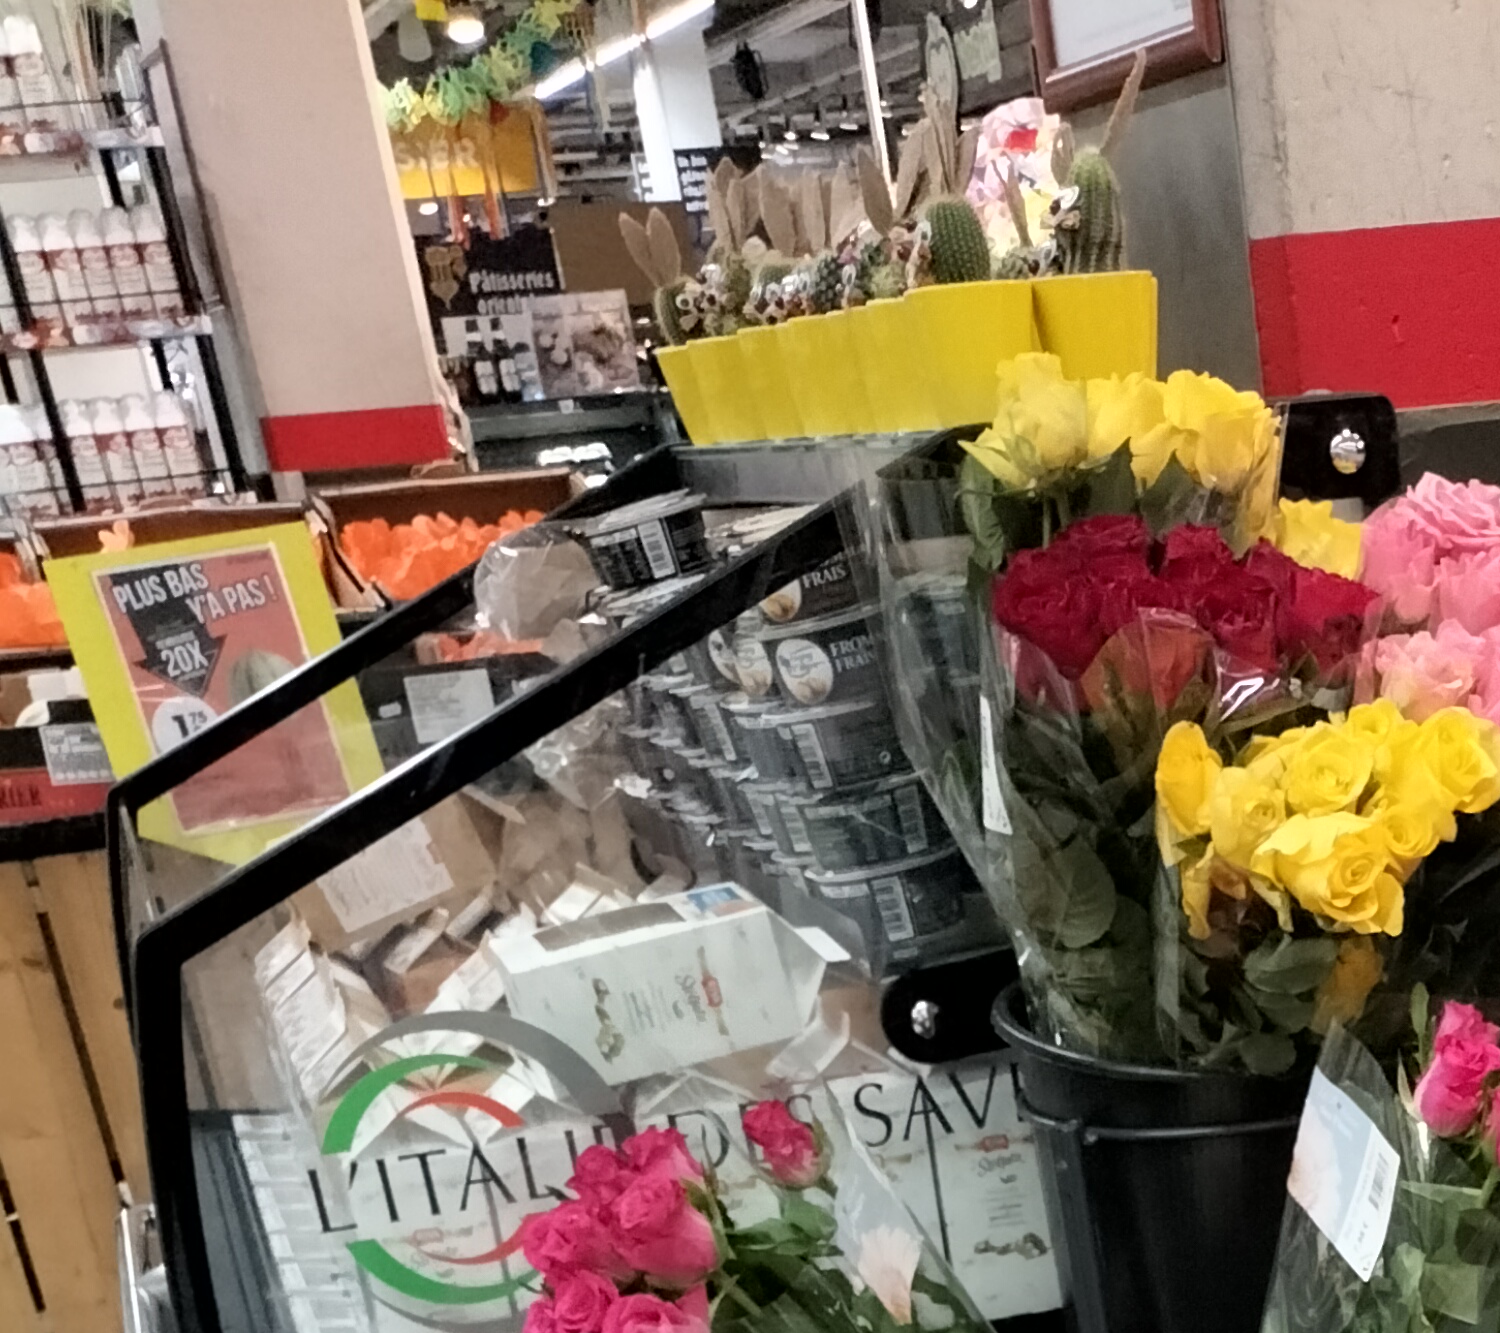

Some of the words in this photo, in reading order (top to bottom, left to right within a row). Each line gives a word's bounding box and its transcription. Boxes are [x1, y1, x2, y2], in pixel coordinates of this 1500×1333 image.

[112, 573, 168, 614] PLUS
[163, 562, 210, 600] BAS
[801, 562, 847, 589] FRAIS
[184, 593, 226, 625] Y'A
[221, 579, 268, 617] PAS
[160, 639, 209, 678] 20X
